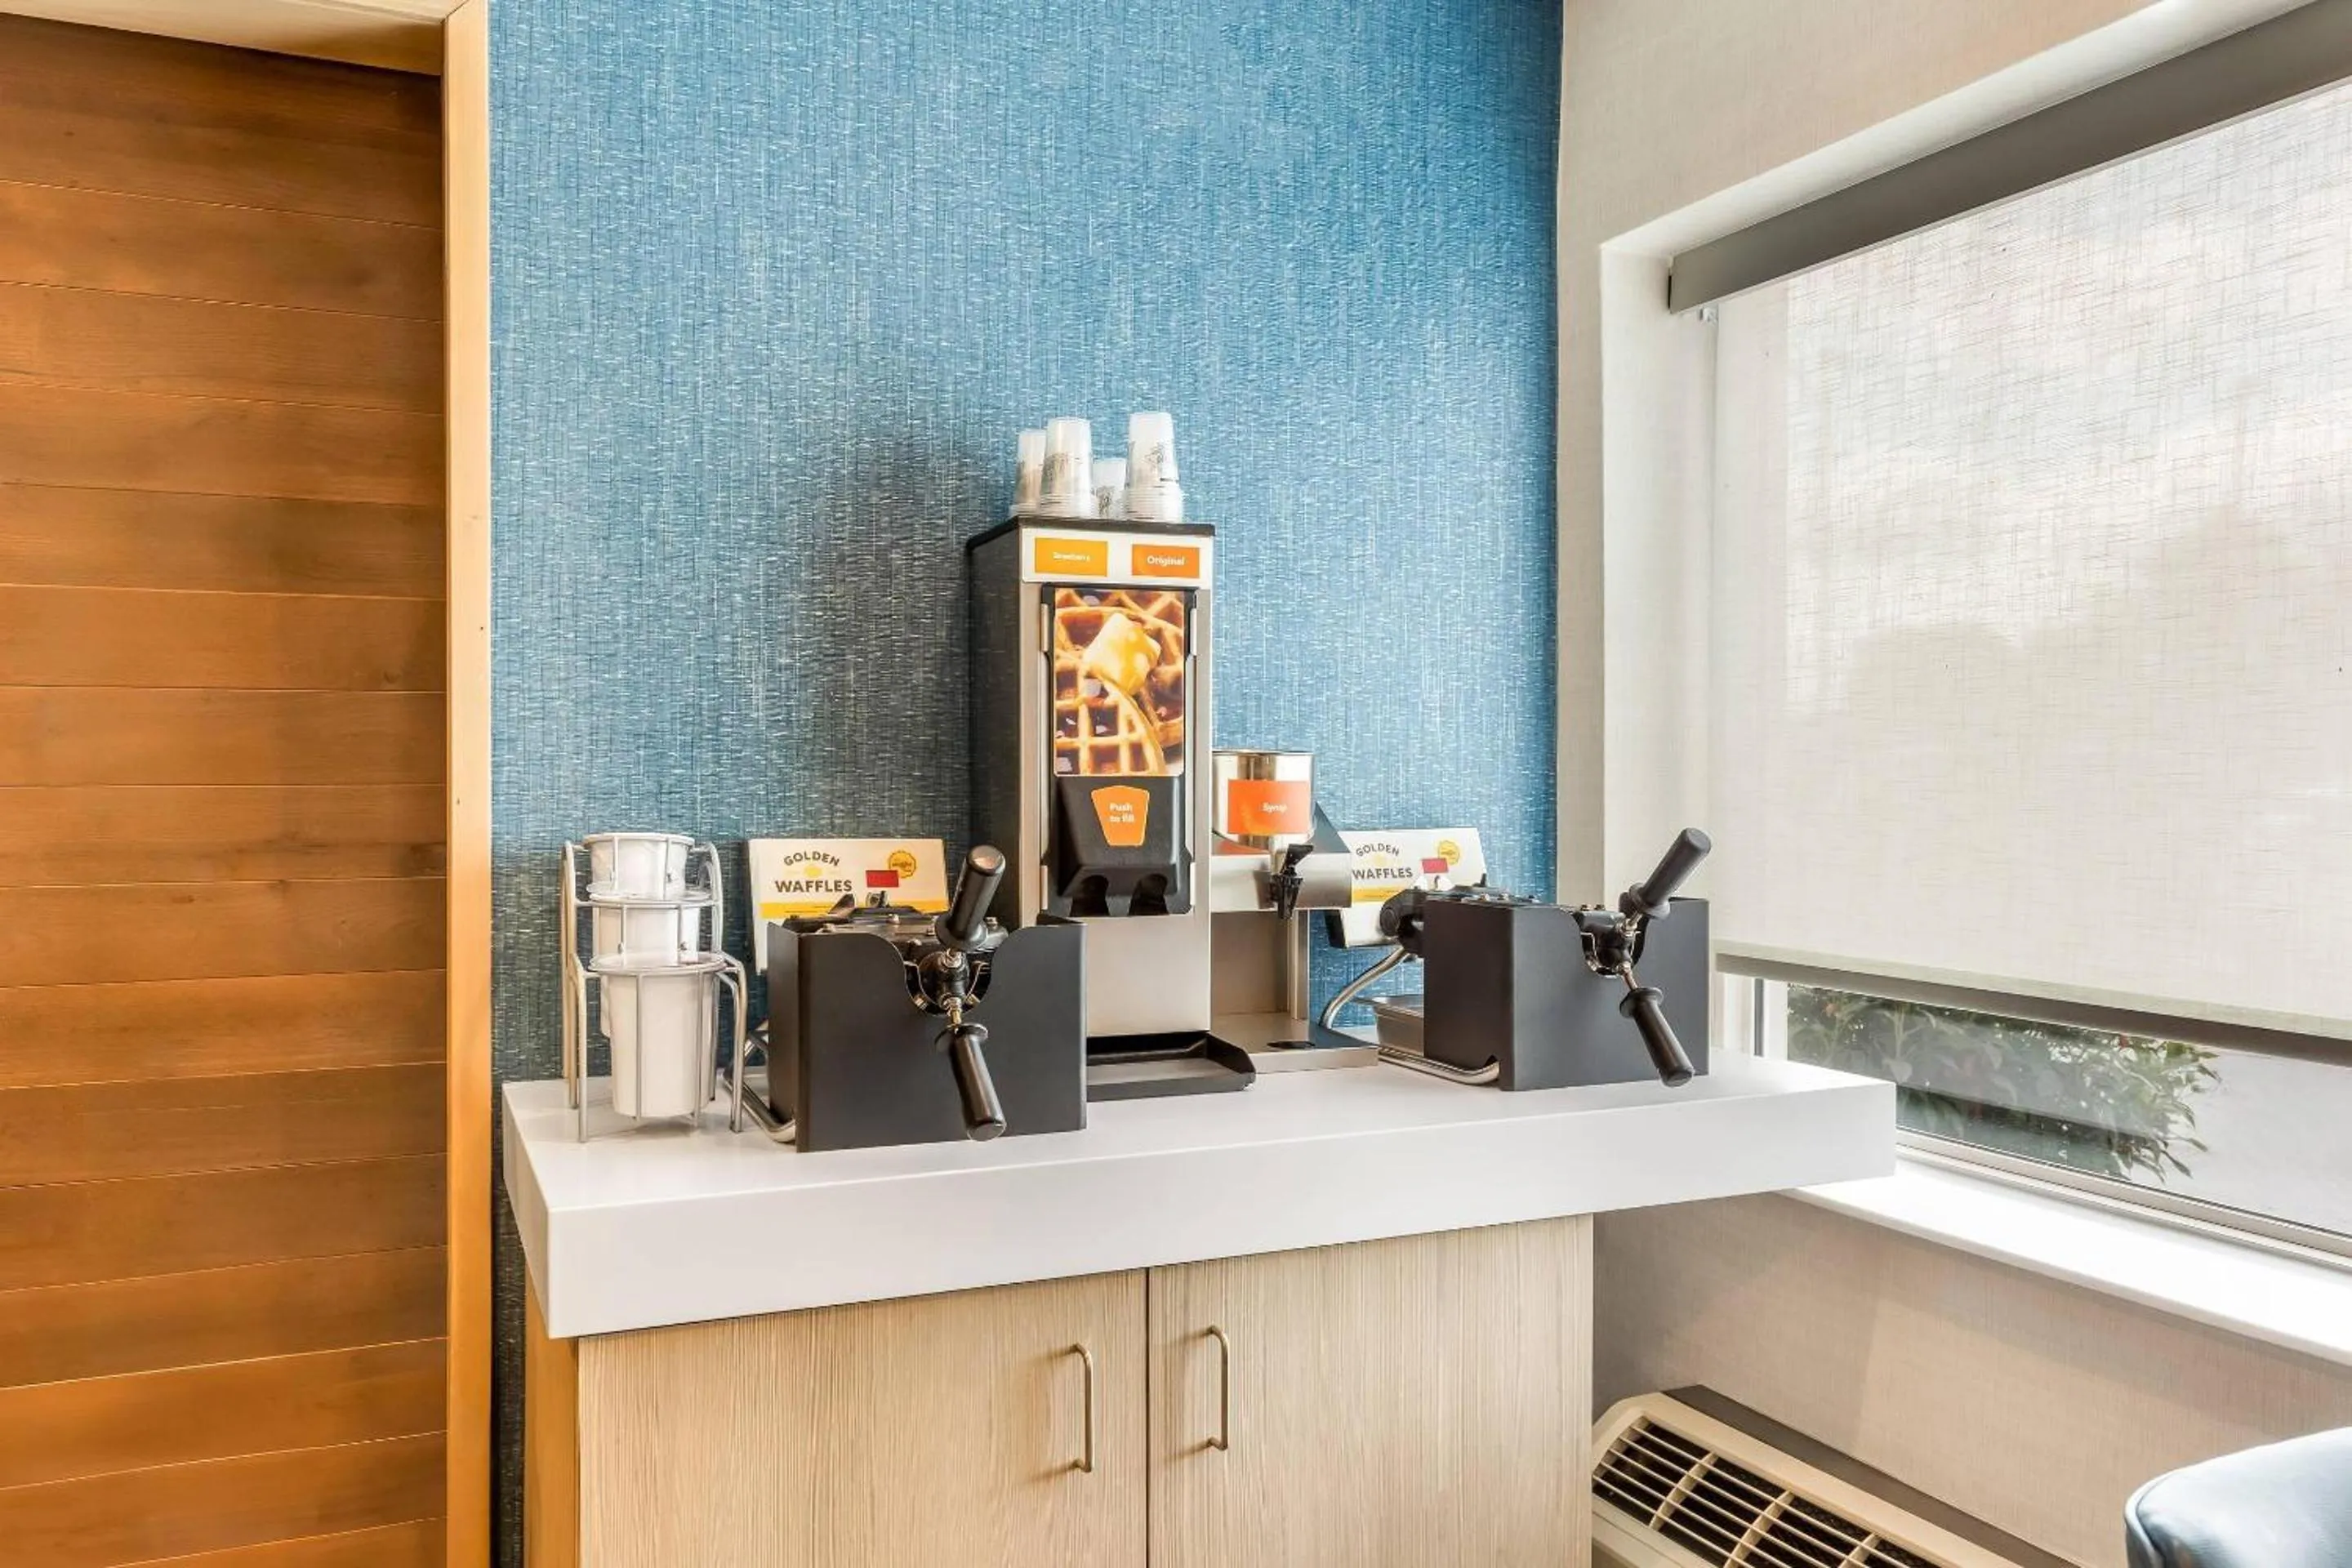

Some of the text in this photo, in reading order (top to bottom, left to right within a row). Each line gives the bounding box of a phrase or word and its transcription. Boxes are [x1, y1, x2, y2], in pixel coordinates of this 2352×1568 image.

[1146, 555, 1185, 568] Original
[1109, 802, 1134, 812] Push
[1262, 801, 1288, 814] Syrup
[1356, 842, 1400, 857] GOLDEN
[783, 850, 840, 867] GOLDEN
[1352, 866, 1414, 880] WAFFLES
[775, 879, 853, 893] WAFFLES
